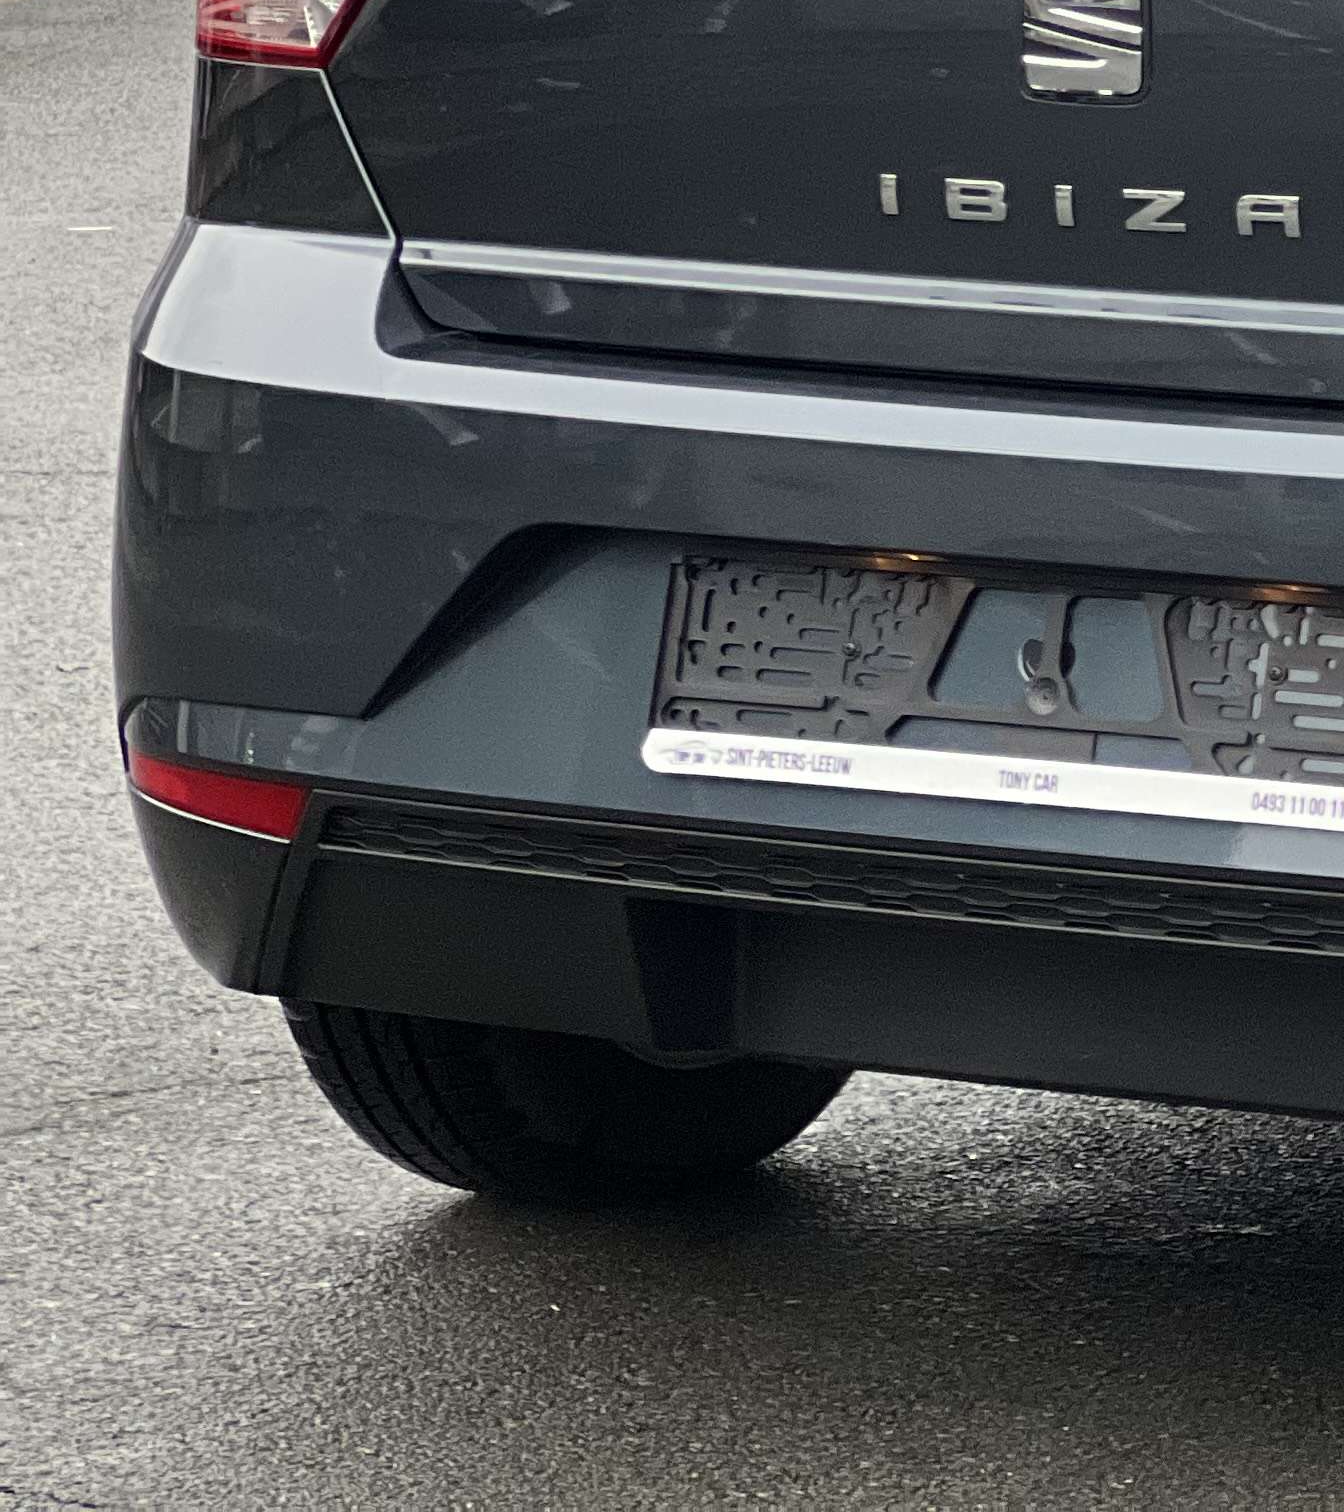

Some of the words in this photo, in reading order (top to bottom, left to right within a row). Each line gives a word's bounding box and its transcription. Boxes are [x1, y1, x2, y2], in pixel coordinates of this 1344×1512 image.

[879, 173, 1301, 239] IBIZA
[726, 748, 852, 775] SINT-PIETERS-LEEUW
[999, 769, 1030, 791] TONY
[1033, 772, 1059, 793] CAR
[1252, 792, 1285, 813] 0493
[1291, 796, 1304, 815] 11
[1309, 797, 1326, 816] 00
